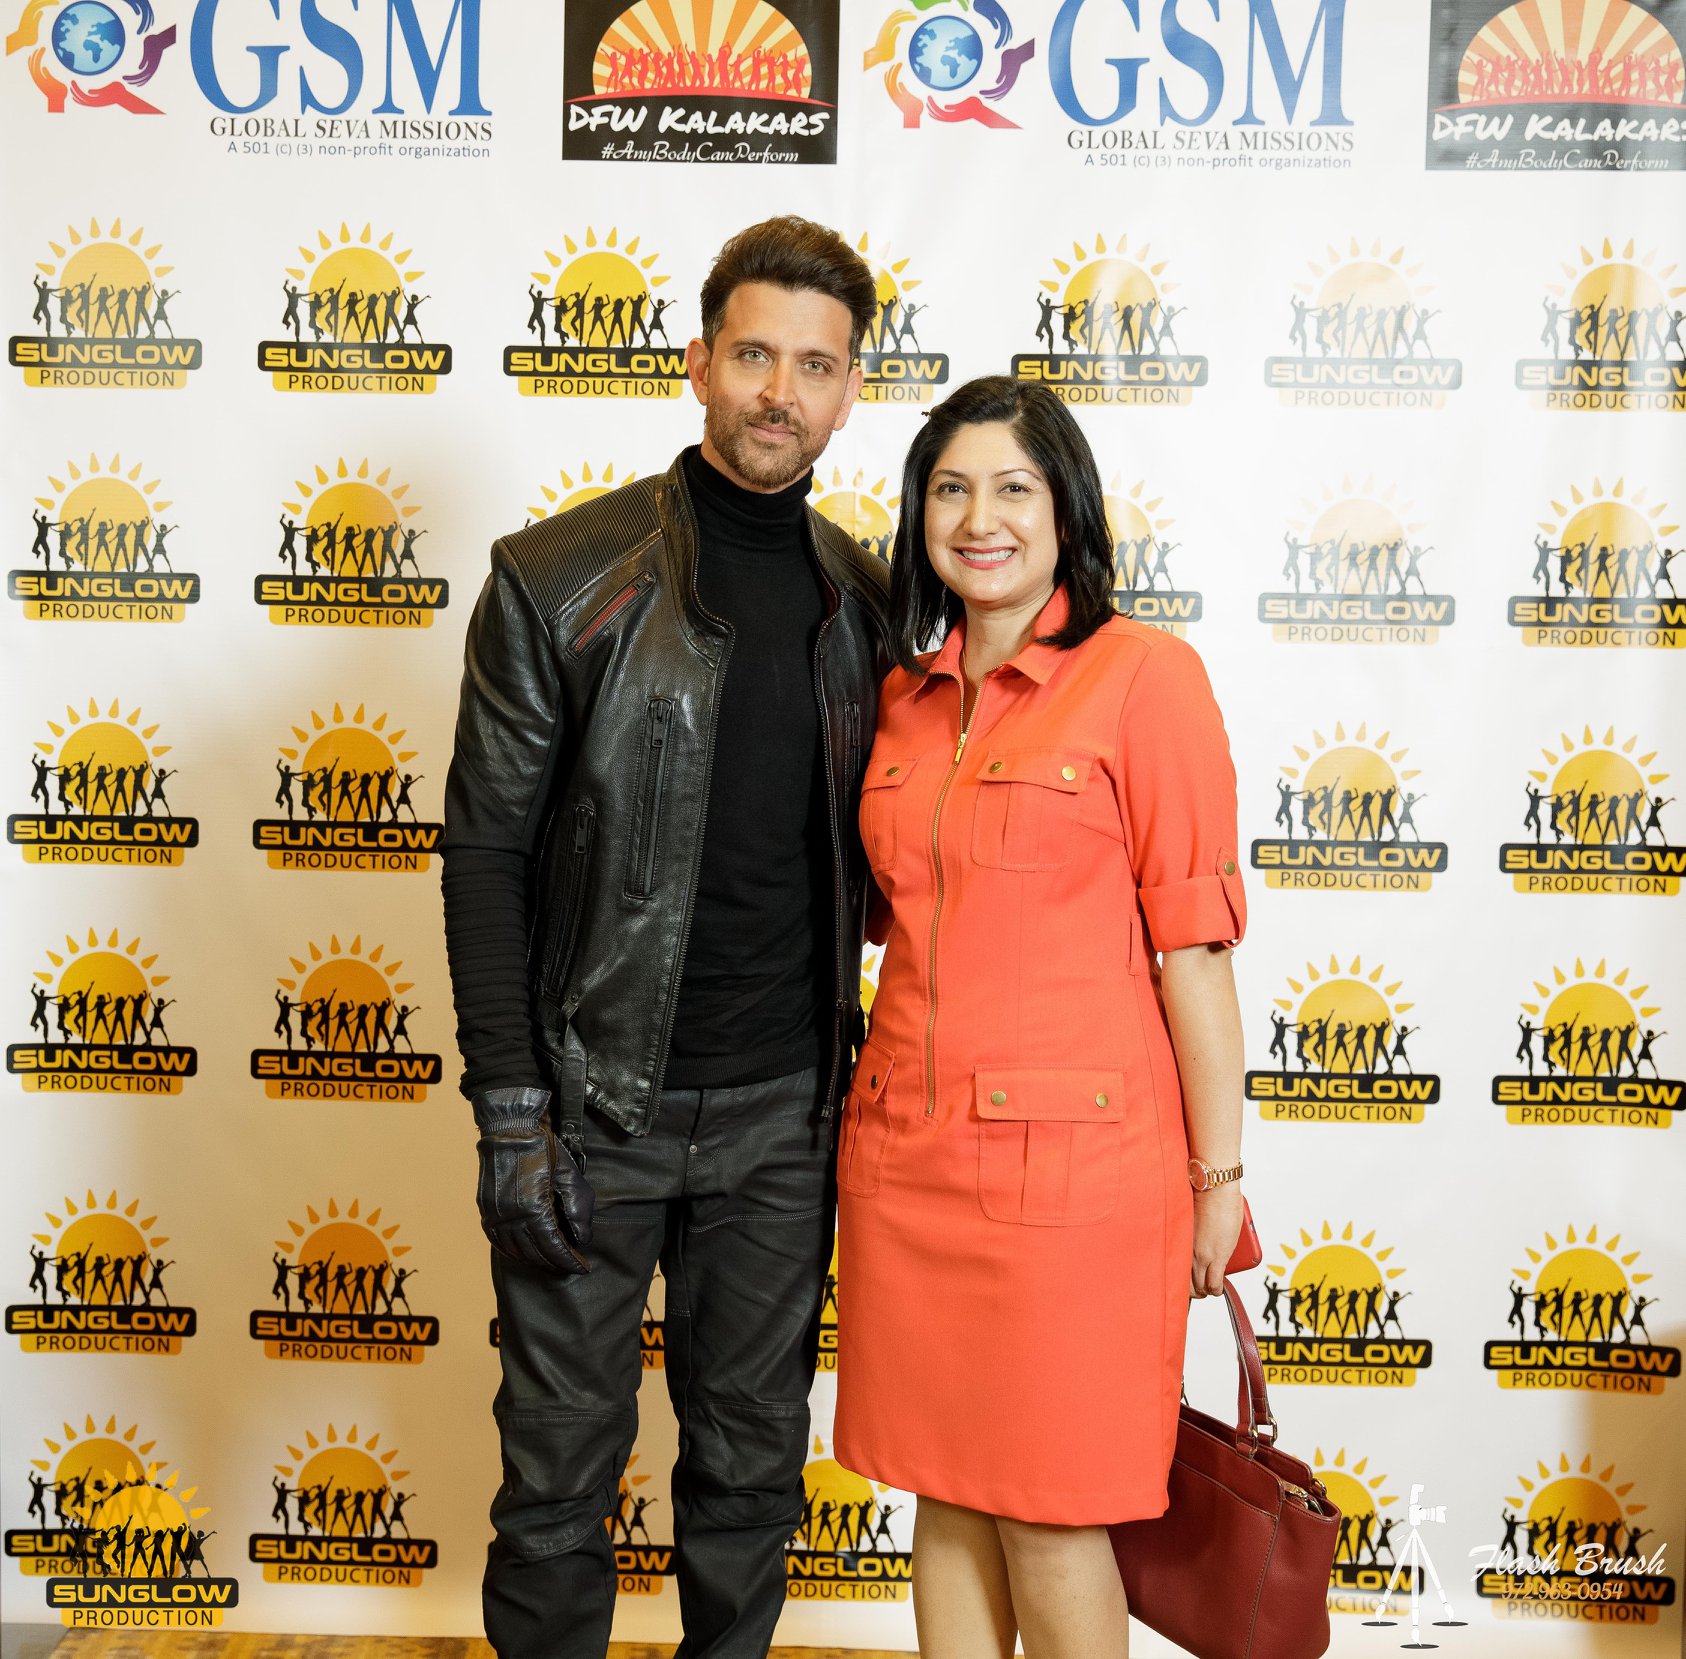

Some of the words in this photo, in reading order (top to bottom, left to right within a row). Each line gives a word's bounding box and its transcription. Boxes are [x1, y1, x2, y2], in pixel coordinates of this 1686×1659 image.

[190, 0, 493, 116] GSM
[1048, 0, 1355, 126] GSM
[210, 117, 306, 138] GLOBAL
[314, 119, 371, 139] SEVA
[380, 120, 493, 141] MISSIONS
[568, 104, 648, 133] DFW
[658, 106, 830, 136] KALAKARS
[1432, 113, 1514, 141] DFW
[227, 141, 238, 153] A
[243, 142, 270, 154] 501
[296, 143, 313, 157] (3)
[318, 143, 393, 157] non-profit
[398, 143, 490, 159] organization
[601, 140, 799, 163] #AnyBodyCanPerform
[1067, 130, 1165, 150] GLOBAL
[1173, 130, 1230, 151] SEVA
[1239, 131, 1354, 152] MISSIONS
[1084, 154, 1095, 166] A
[1100, 154, 1127, 166] 501
[1155, 155, 1171, 168] (3)
[1177, 154, 1253, 170] non-profit
[1258, 155, 1351, 170] organization
[1465, 149, 1669, 171] #AnyBodyCanPerform
[15, 343, 195, 365] SUNGLOW
[264, 348, 446, 370] SUNGLOW
[510, 352, 687, 374] SUNGLOW
[40, 369, 175, 388] PRODUCTION
[1018, 361, 1201, 382] SUNGLOW
[1271, 362, 1454, 385] SUNGLOW
[289, 375, 425, 392] PRODUCTION
[534, 379, 670, 396] PRODUCTION
[1058, 387, 1180, 403] RODUCTION
[1294, 389, 1434, 407] PRODUCTION
[1547, 392, 1686, 409] PRODUCTION
[14, 575, 194, 598] SUNGLOW
[261, 580, 442, 603] SUNGLOW
[40, 603, 173, 620] PRODUCTION
[285, 608, 421, 625] PRODUCTION
[1264, 600, 1448, 621] SUNGLOW
[1514, 602, 1686, 624] SUNGLOW
[1288, 625, 1426, 643] PRODUCTION
[1538, 629, 1676, 646] PRODUCTION
[13, 820, 193, 843] SUNGLOW
[259, 825, 440, 848] SUNGLOW
[39, 846, 173, 864] PRODUCTION
[283, 853, 418, 870] PRODUCTION
[1256, 846, 1442, 868] SUNGLOW
[1505, 849, 1686, 873] SUNGLOW
[1280, 872, 1420, 890] PRODUCTION
[1529, 876, 1667, 893] PRODUCTION
[13, 1049, 191, 1072] SUNGLOW
[257, 1055, 435, 1079] SUNGLOW
[37, 1074, 171, 1092] PRODUCTION
[281, 1081, 415, 1100] PRODUCTION
[1251, 1077, 1434, 1100] SUNGLOW
[1497, 1082, 1682, 1106] SUNGLOW
[1275, 1103, 1412, 1121] PRODUCTION
[1522, 1107, 1659, 1126] PRODUCTION
[11, 1310, 190, 1333] SUNGLOW
[256, 1317, 433, 1341] SUNGLOW
[36, 1335, 170, 1352] PRODUCTION
[279, 1343, 413, 1361] PRODUCTION
[1489, 1345, 1671, 1372] SUNGLOW
[1268, 1367, 1404, 1384] PRODUCTION
[1513, 1371, 1651, 1392] PRODUCTION
[255, 1542, 431, 1563] SUNGLOW
[278, 1566, 410, 1584] PRODUCTION
[787, 1555, 912, 1578] NGLOW
[788, 1582, 896, 1599] ODUCTION
[1508, 1601, 1646, 1621] PRODUCTION
